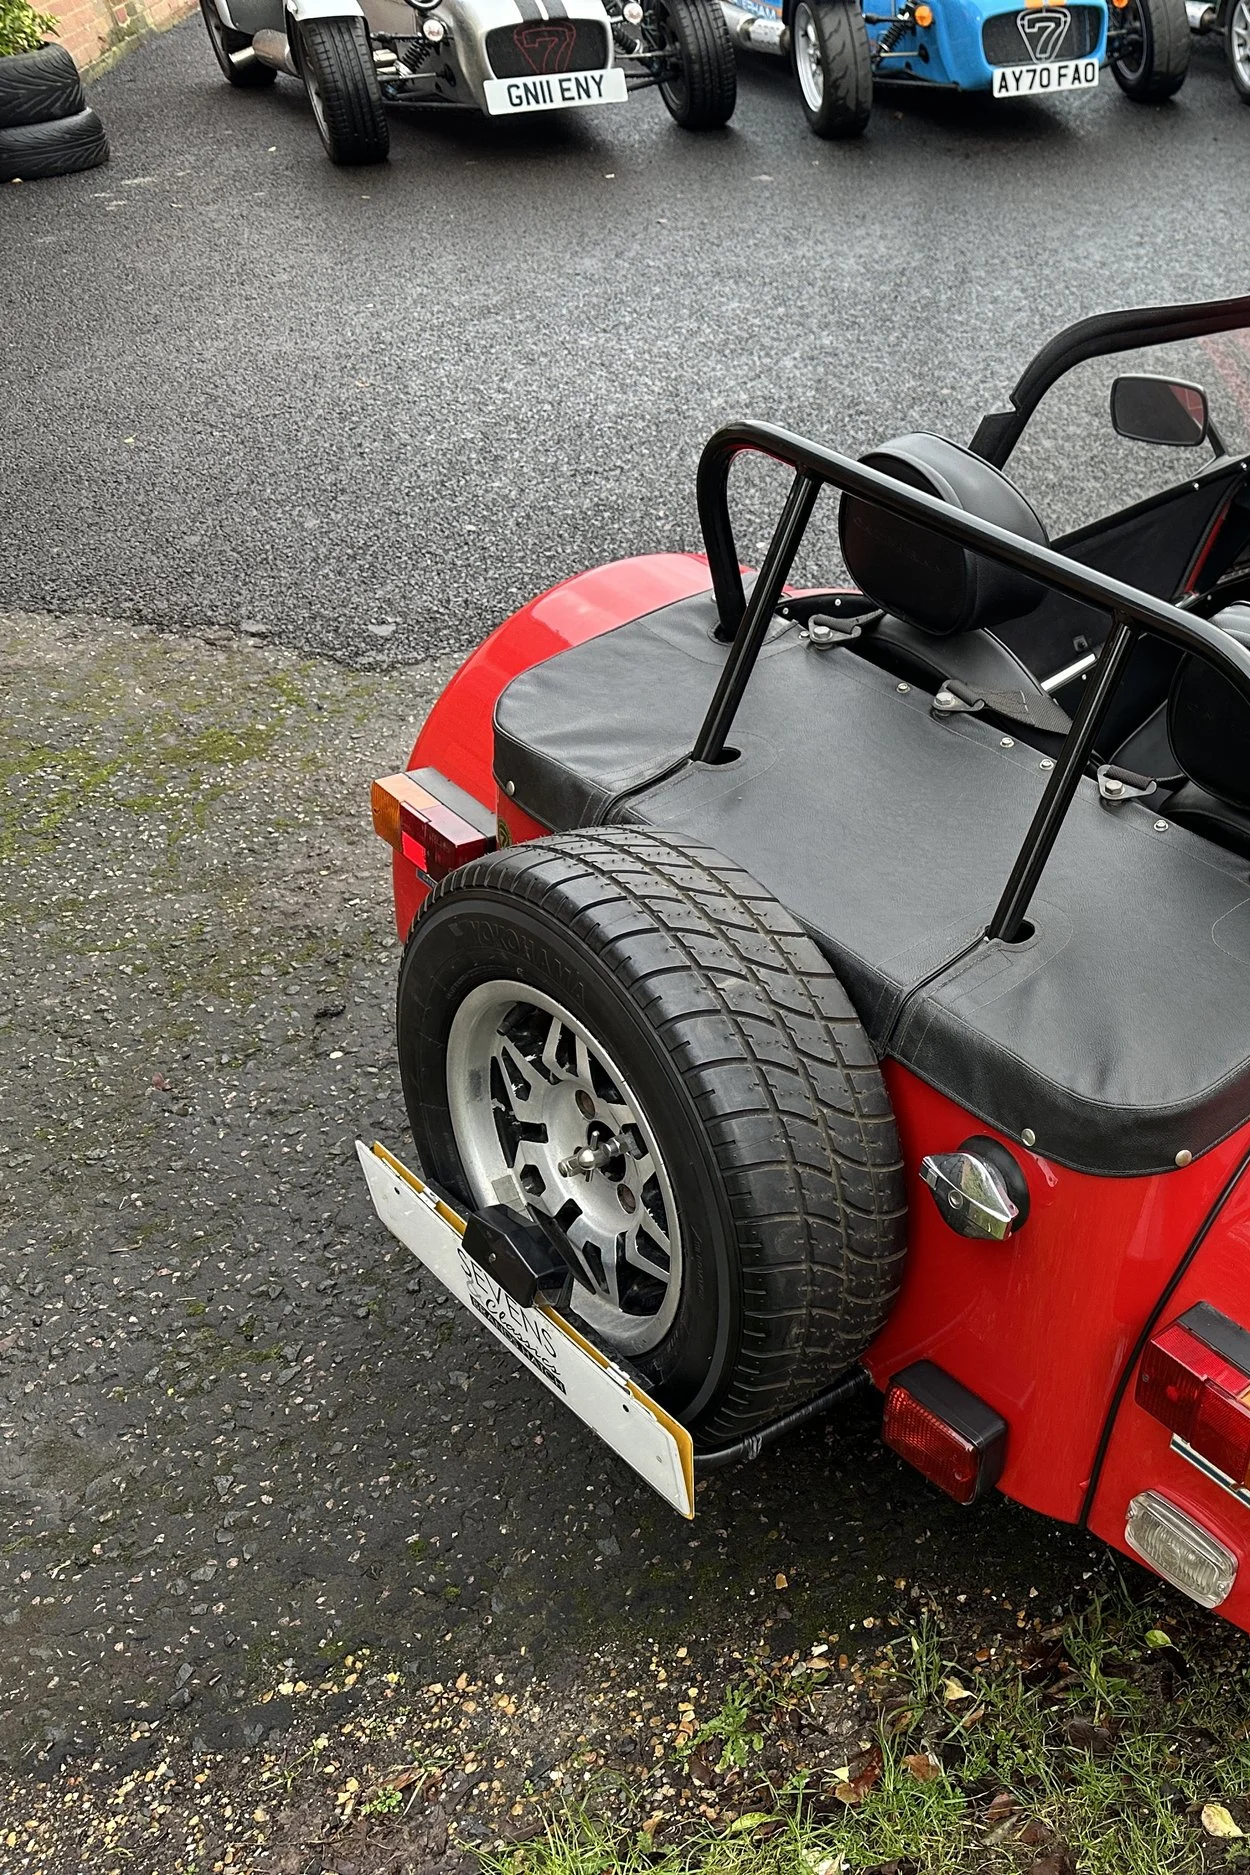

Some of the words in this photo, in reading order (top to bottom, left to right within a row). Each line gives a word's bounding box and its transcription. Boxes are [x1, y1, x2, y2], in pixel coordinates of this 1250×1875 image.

[1023, 13, 1065, 58] 7
[507, 79, 554, 107] GN11
[558, 74, 604, 101] ENY
[998, 68, 1050, 93] AY70
[1057, 62, 1096, 87] FAO
[470, 920, 586, 1008] YOKOHAMA
[457, 1248, 557, 1358] SEVENS
[485, 1298, 561, 1376] Classics
